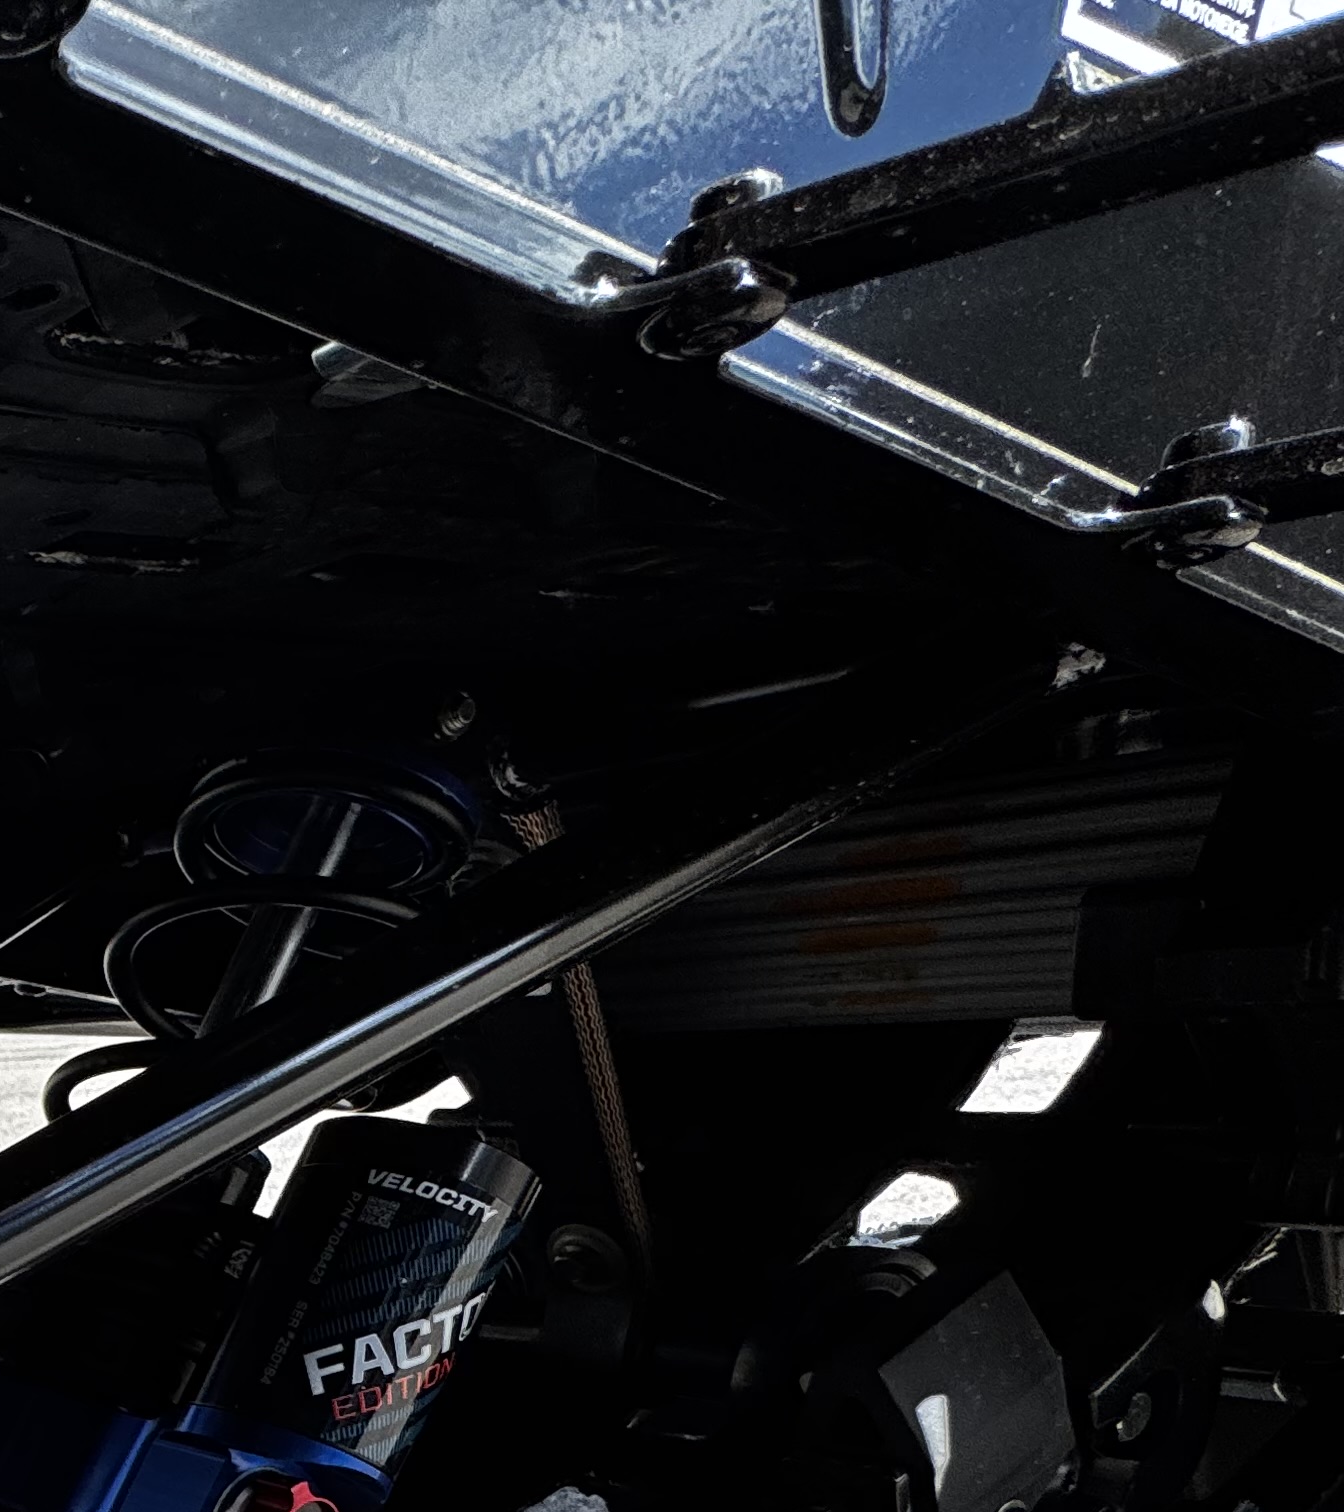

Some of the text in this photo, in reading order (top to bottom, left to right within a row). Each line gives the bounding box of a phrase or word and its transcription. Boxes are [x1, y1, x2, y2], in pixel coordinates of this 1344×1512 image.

[367, 1169, 498, 1222] VELOCITY
[303, 1281, 495, 1396] FACTO
[331, 1352, 456, 1421] EDITION
